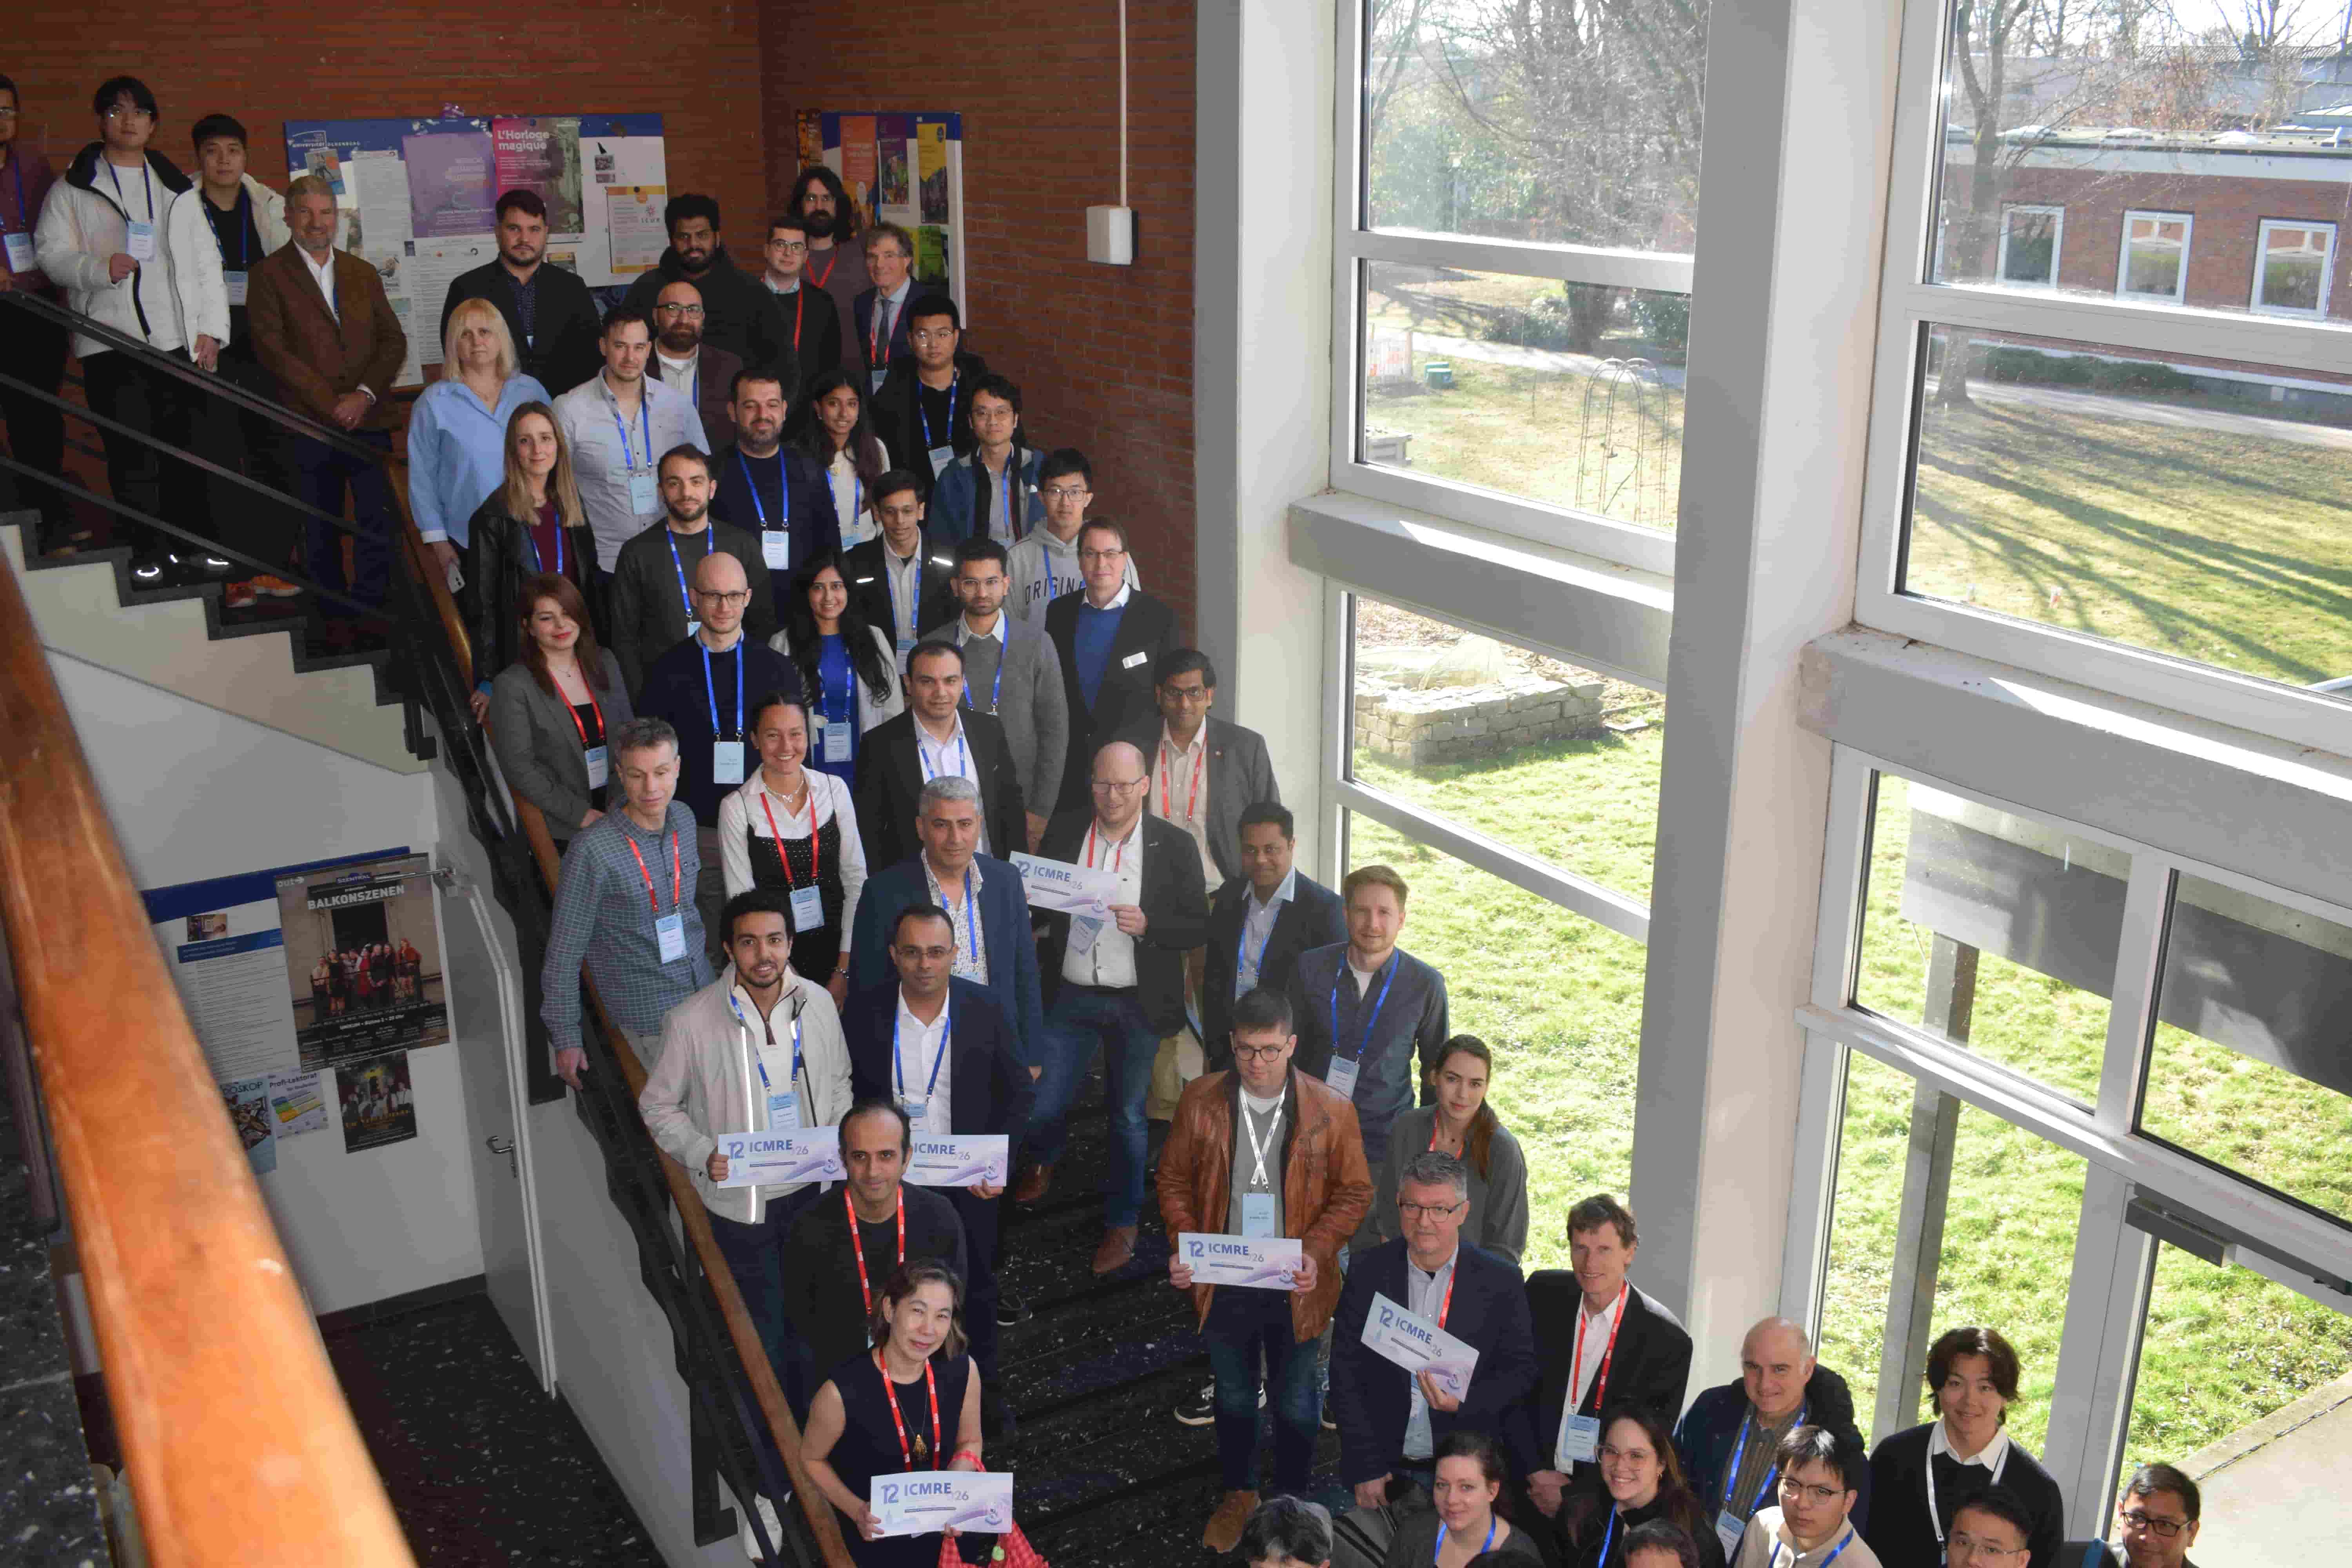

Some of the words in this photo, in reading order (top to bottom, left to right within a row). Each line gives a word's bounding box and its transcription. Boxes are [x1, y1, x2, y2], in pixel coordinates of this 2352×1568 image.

[499, 140, 547, 152] magique
[1025, 577, 1083, 606] ORIGIN
[1034, 865, 1071, 882] ICMRE
[308, 885, 405, 910] BALKONSZENEN
[728, 1141, 745, 1160] 12
[749, 1139, 793, 1152] ICMRE
[914, 1143, 956, 1154] ICMRE
[1188, 1240, 1204, 1257] 12
[1208, 1243, 1249, 1256] ICMRE
[1380, 1305, 1394, 1328] 12
[1396, 1316, 1433, 1344] ICMRE
[881, 1484, 899, 1504] 12
[904, 1483, 952, 1496] ICMRE
